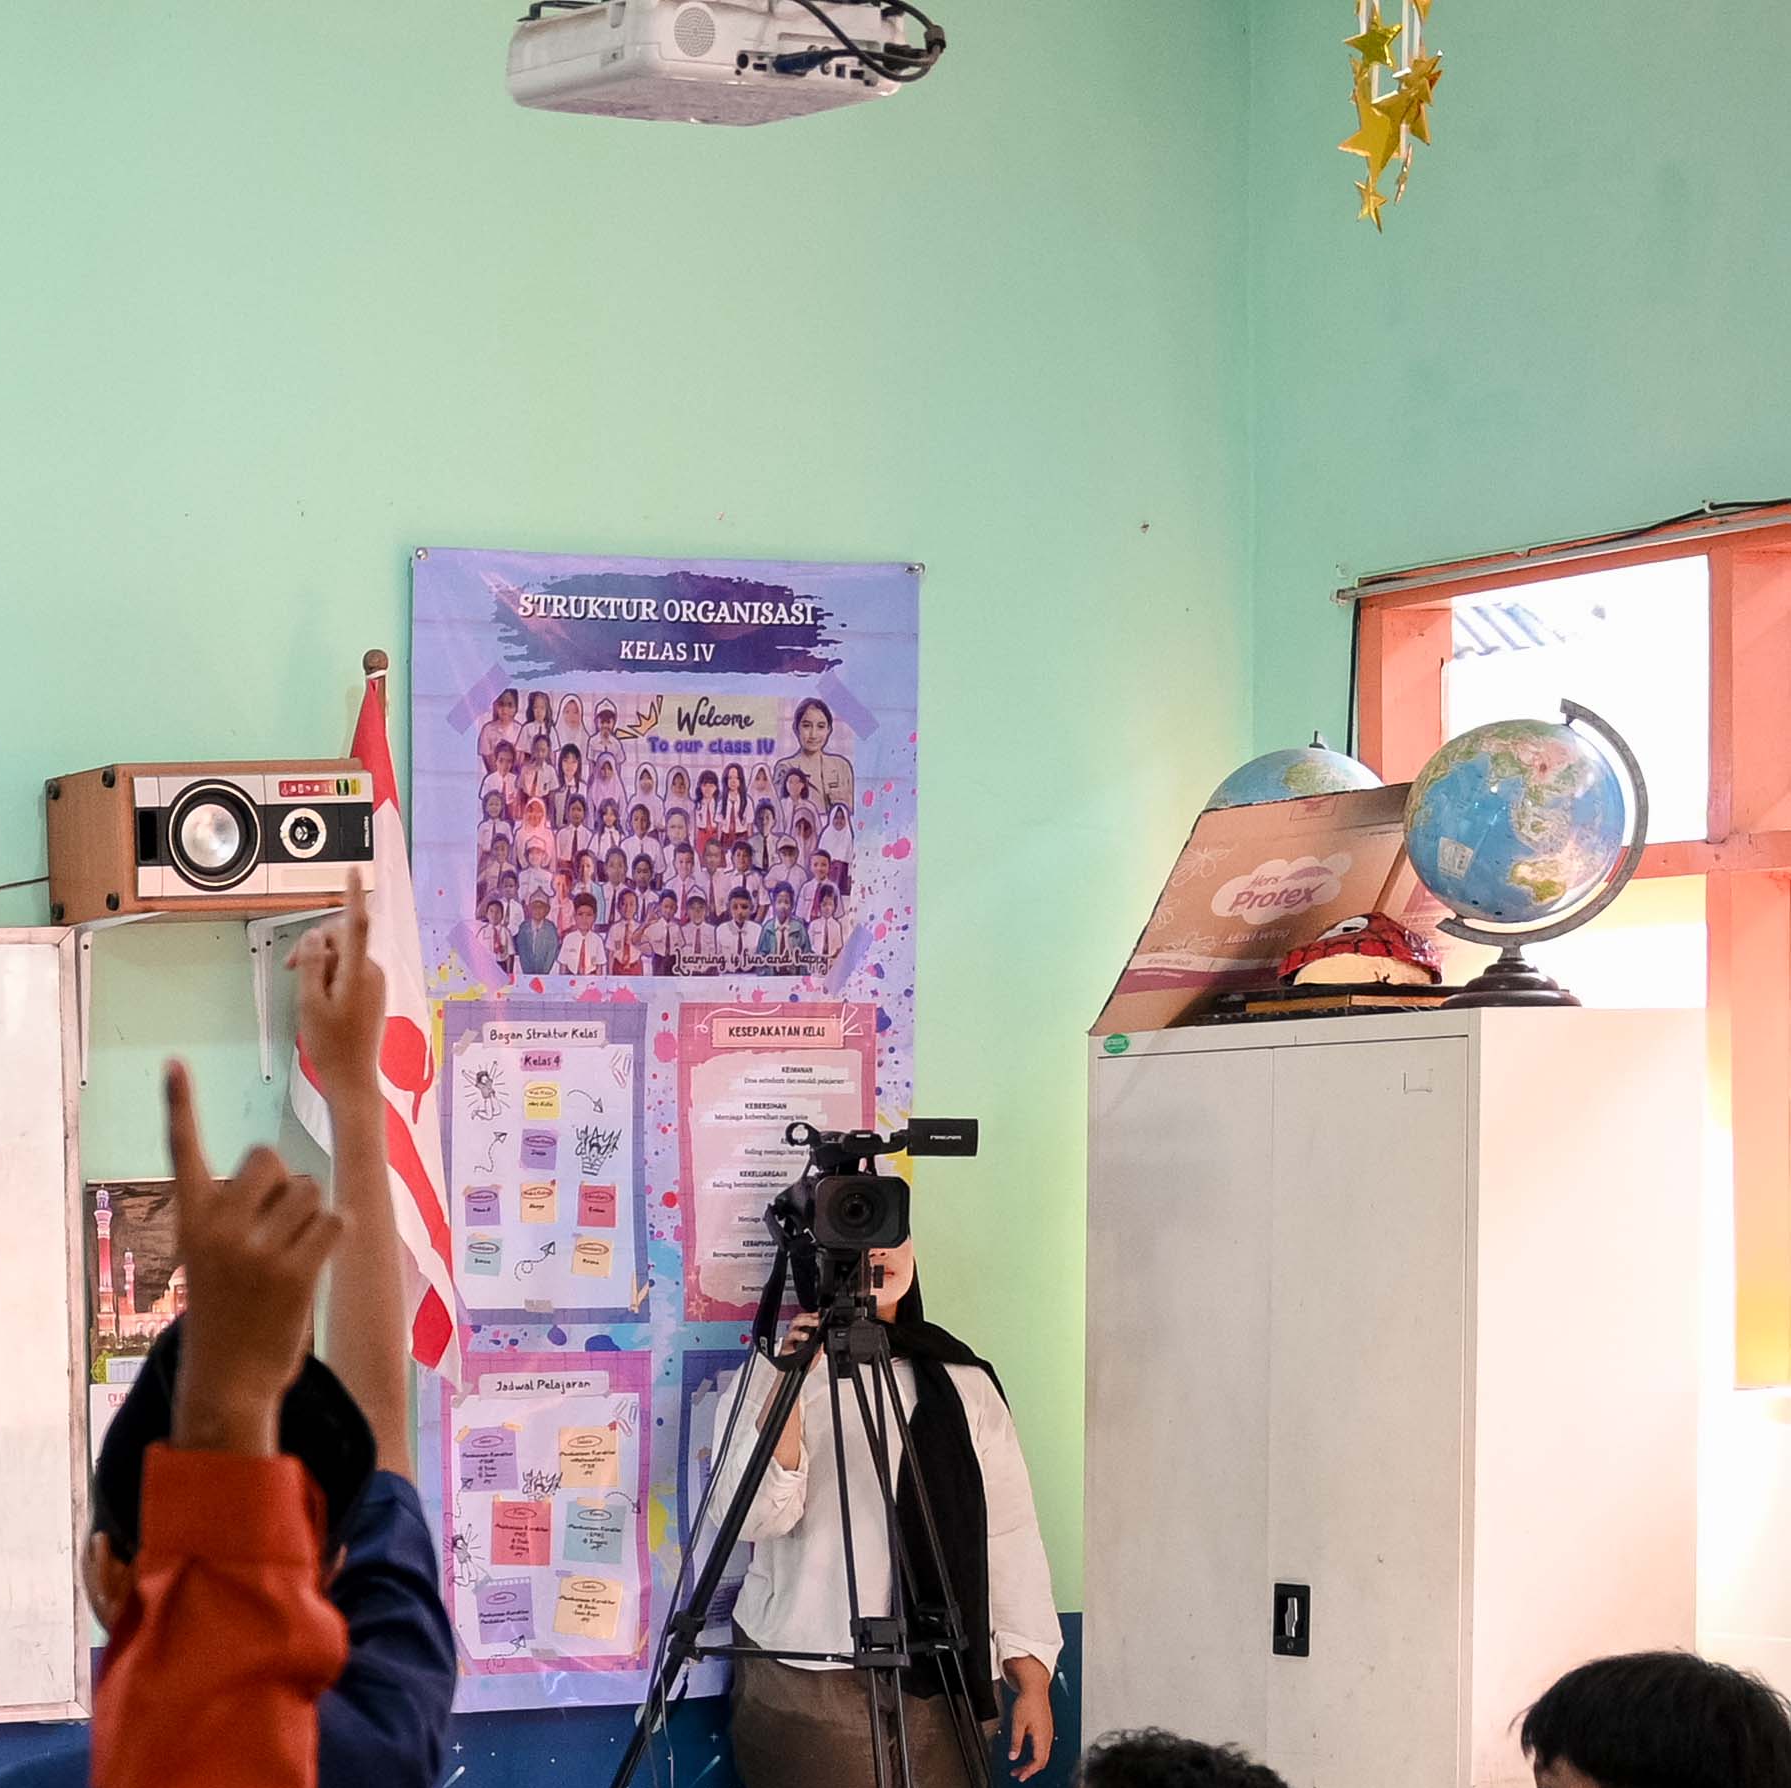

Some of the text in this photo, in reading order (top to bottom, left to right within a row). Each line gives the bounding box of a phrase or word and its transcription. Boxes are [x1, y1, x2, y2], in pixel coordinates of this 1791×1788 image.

[518, 594, 816, 626] STRUKTUR ORGANISASI
[619, 640, 716, 662] KELAS IV
[677, 696, 755, 736] Welcome
[648, 736, 775, 755] To our class IV
[1228, 881, 1326, 914] Protex
[673, 948, 728, 977] Learning
[742, 948, 766, 968] fun
[767, 950, 792, 965] and
[794, 949, 829, 976] happy
[489, 1027, 599, 1043] Bagan Struktur Kelas
[728, 1026, 826, 1038] KESEPAKATAN KELAS
[523, 1055, 560, 1066] Kelas 4
[496, 1378, 591, 1395] Jadwal Pelajaran
